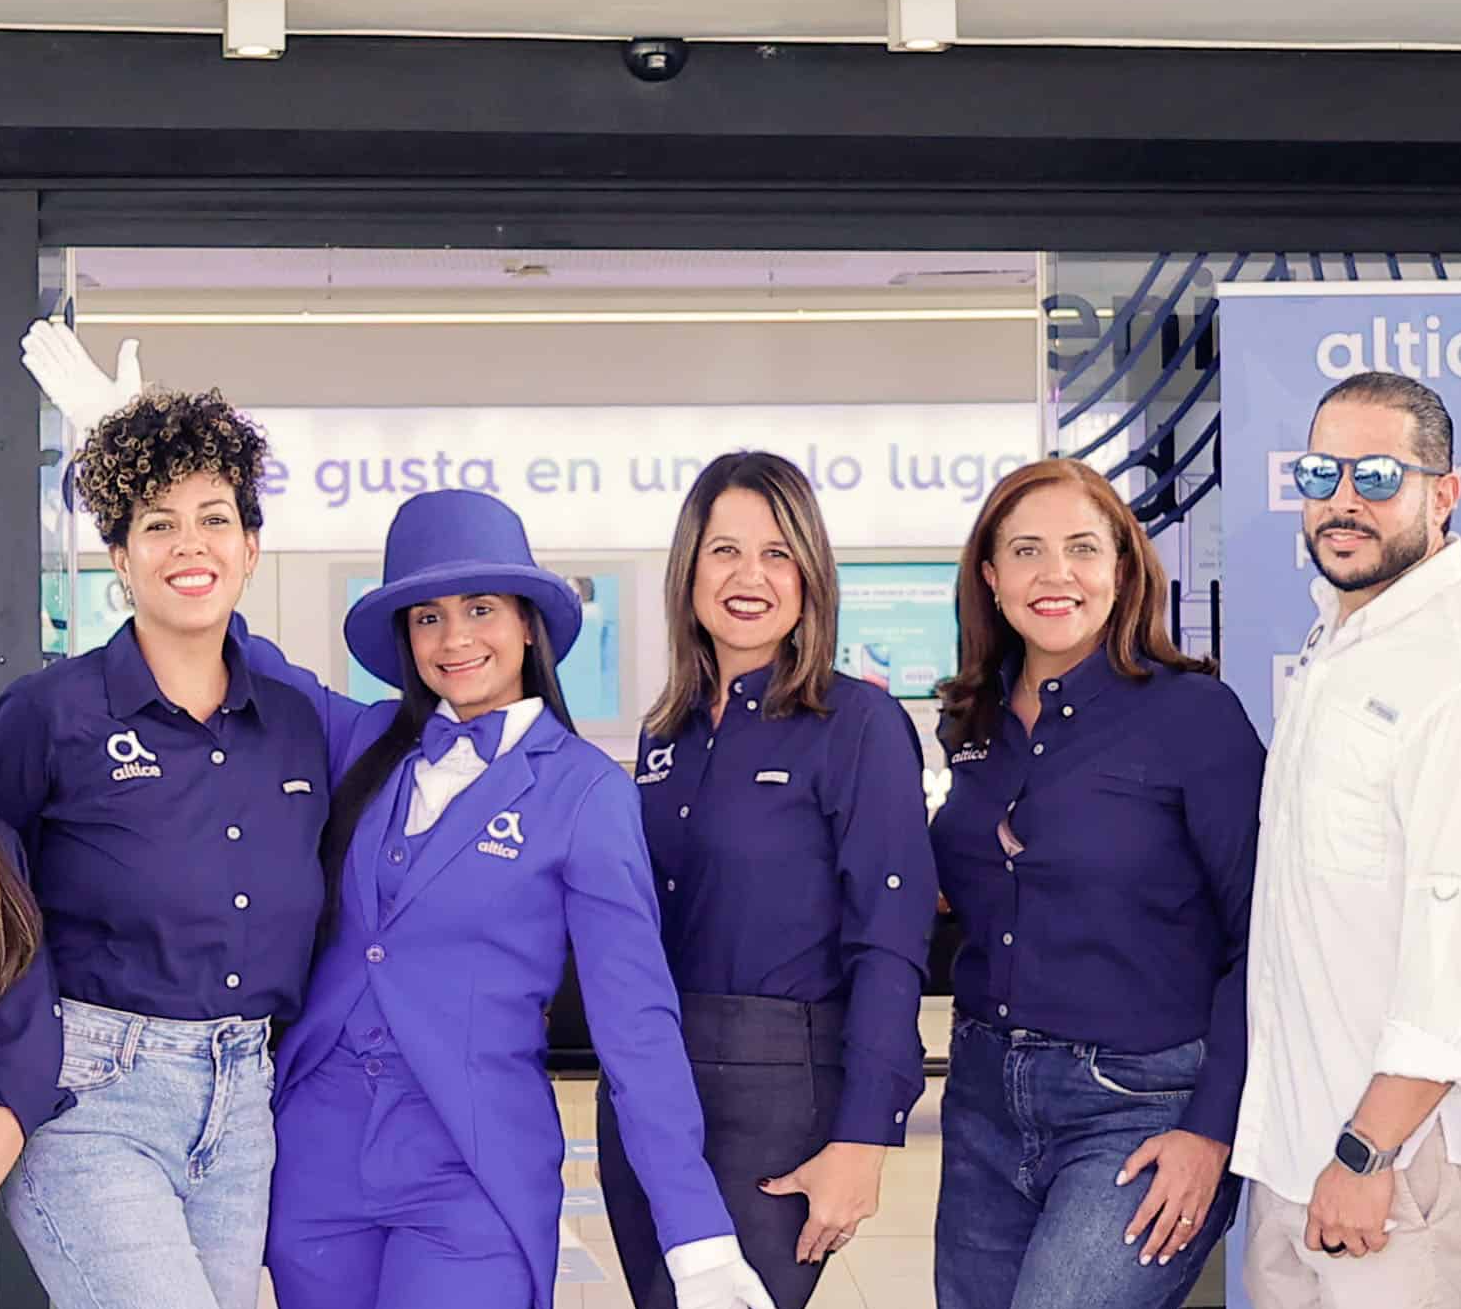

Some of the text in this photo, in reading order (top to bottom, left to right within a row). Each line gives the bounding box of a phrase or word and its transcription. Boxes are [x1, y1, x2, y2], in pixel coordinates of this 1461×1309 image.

[315, 451, 500, 508] gusta
[526, 457, 601, 493] en
[807, 443, 863, 490] lo
[112, 762, 162, 781] altice
[477, 840, 519, 860] altice
